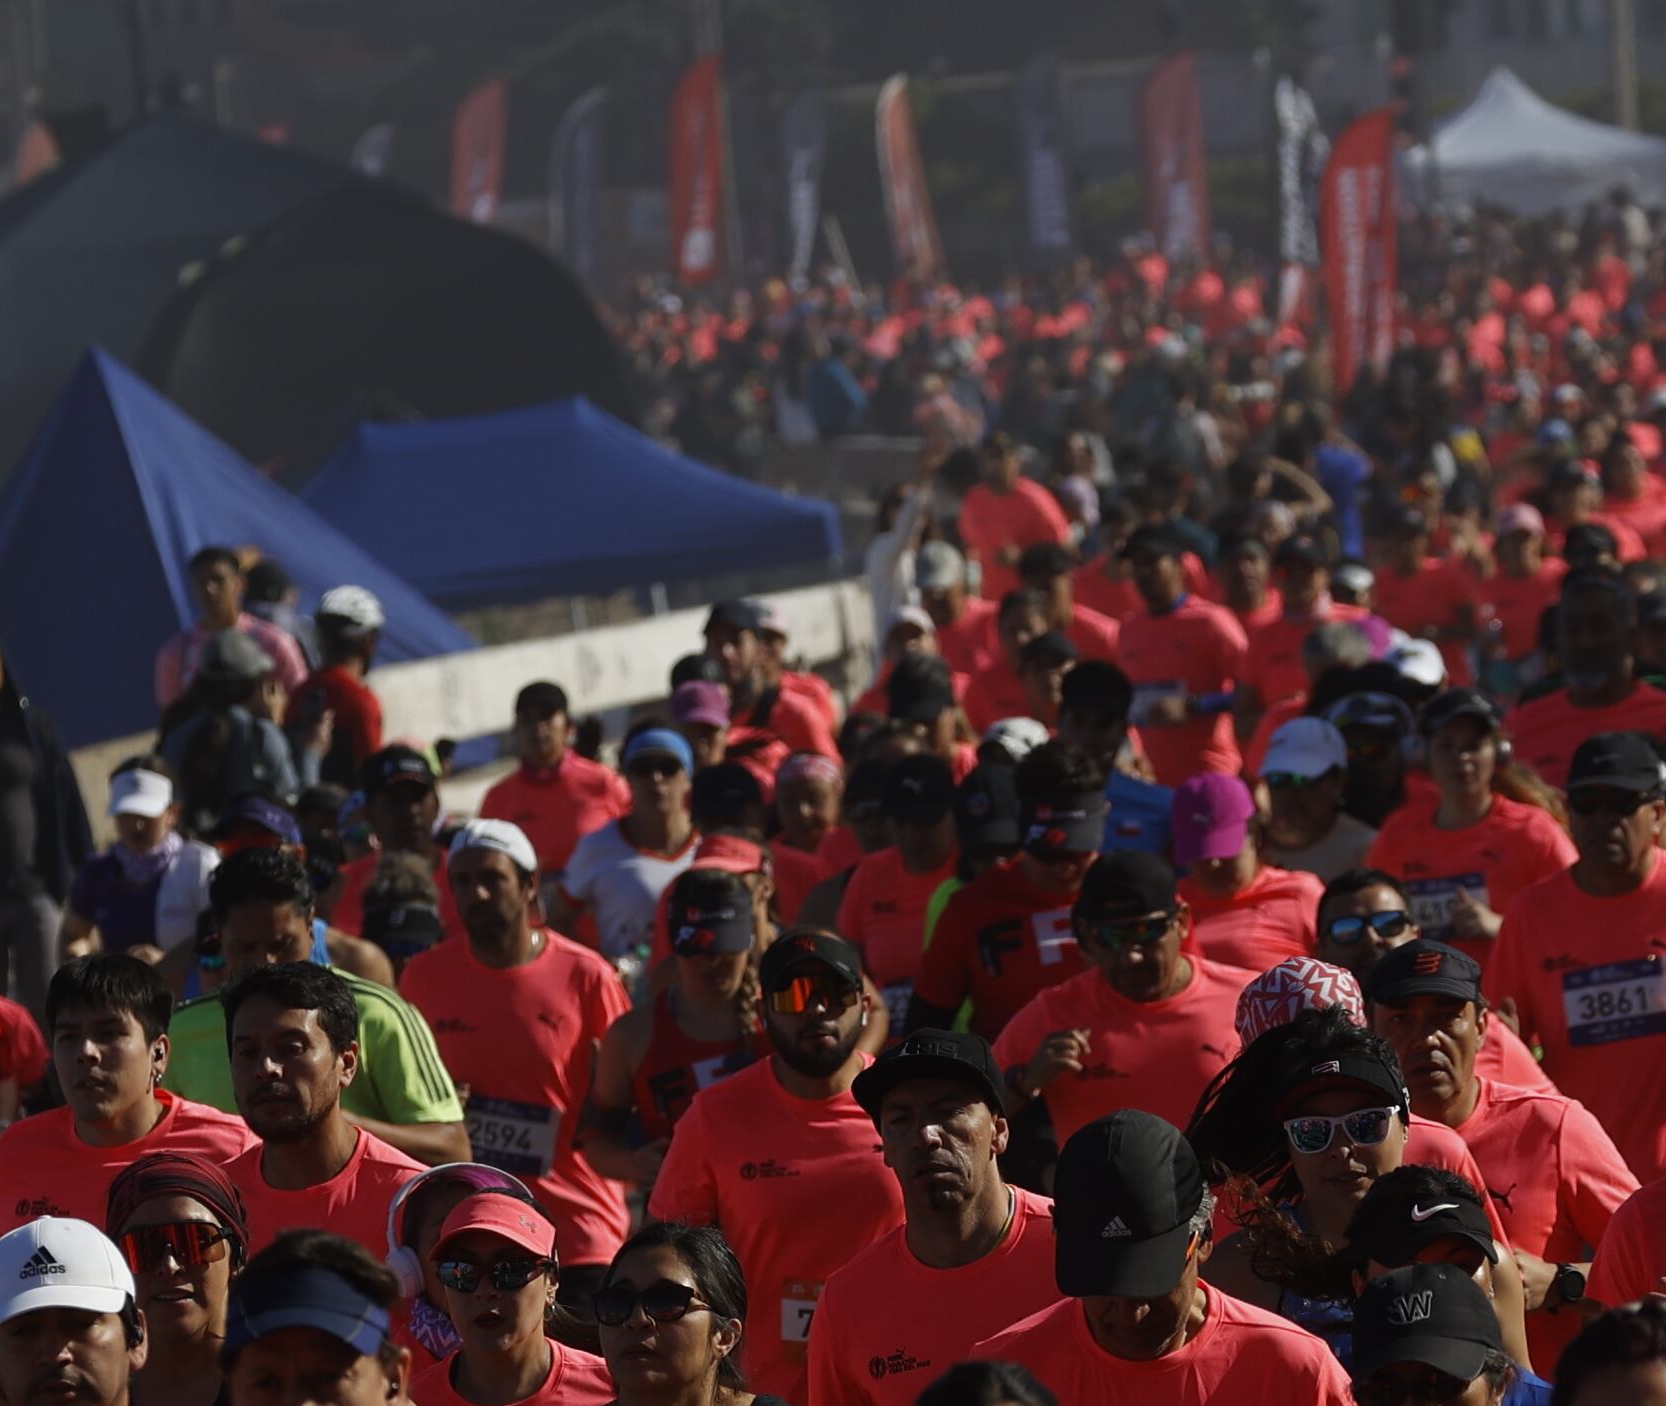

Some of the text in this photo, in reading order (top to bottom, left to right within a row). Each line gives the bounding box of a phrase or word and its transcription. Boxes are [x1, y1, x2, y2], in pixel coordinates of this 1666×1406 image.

[1580, 986, 1650, 1021] 3861
[469, 1117, 533, 1151] 2594
[1101, 1229, 1132, 1238] adidas
[19, 1262, 66, 1279] adidas
